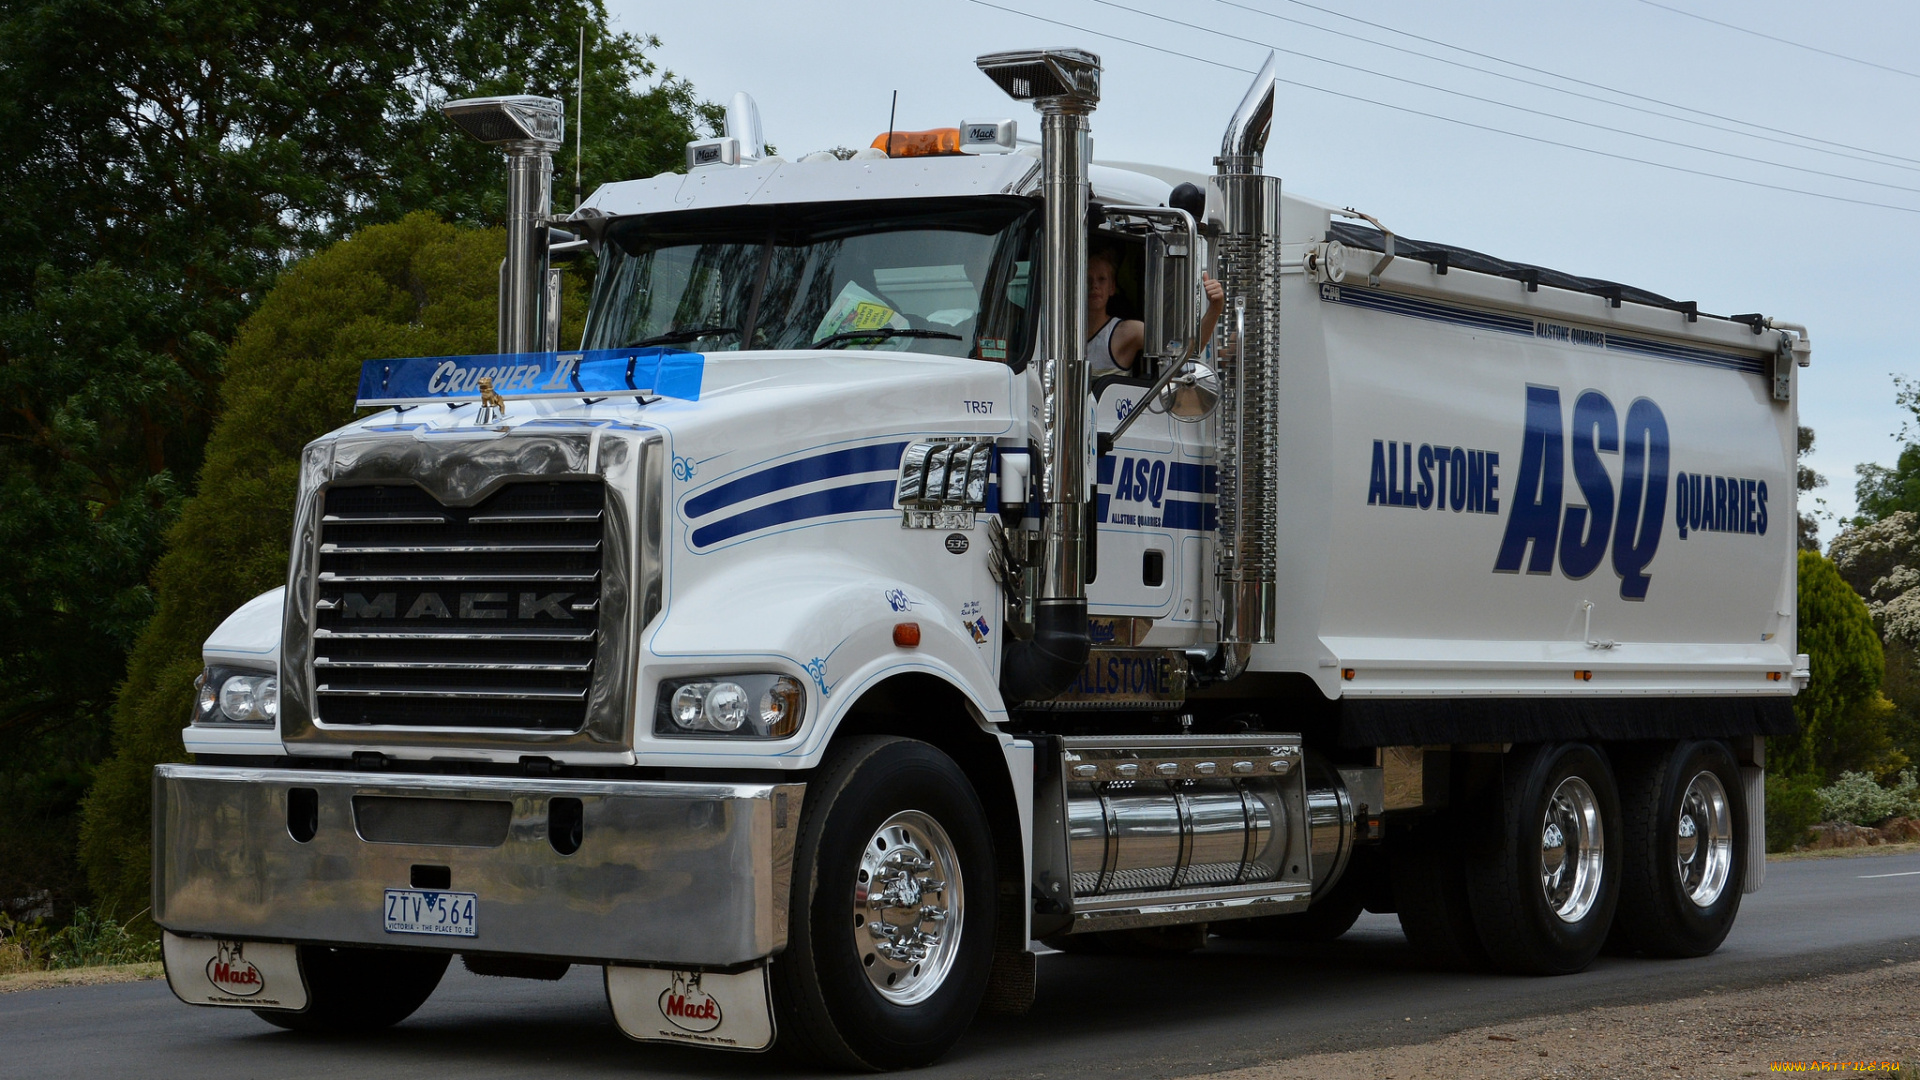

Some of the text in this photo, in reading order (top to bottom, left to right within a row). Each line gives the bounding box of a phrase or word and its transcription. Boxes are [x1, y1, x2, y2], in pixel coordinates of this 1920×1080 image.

[970, 128, 995, 140] Mack
[696, 149, 719, 161] Mack
[1536, 322, 1604, 348] ALLSTONE QUARRIES
[541, 354, 583, 390] II
[964, 401, 993, 414] TR57
[1116, 457, 1165, 508] ASQ
[1367, 382, 1768, 602] ALLSTONE ASQ QUARRIES
[1112, 513, 1161, 528] ALLSTONE QUARRIES
[947, 540, 968, 548] 535
[342, 592, 575, 619] MACK
[388, 895, 473, 925] ZTV 564
[214, 963, 260, 984] Mack
[667, 995, 718, 1020] Mack
